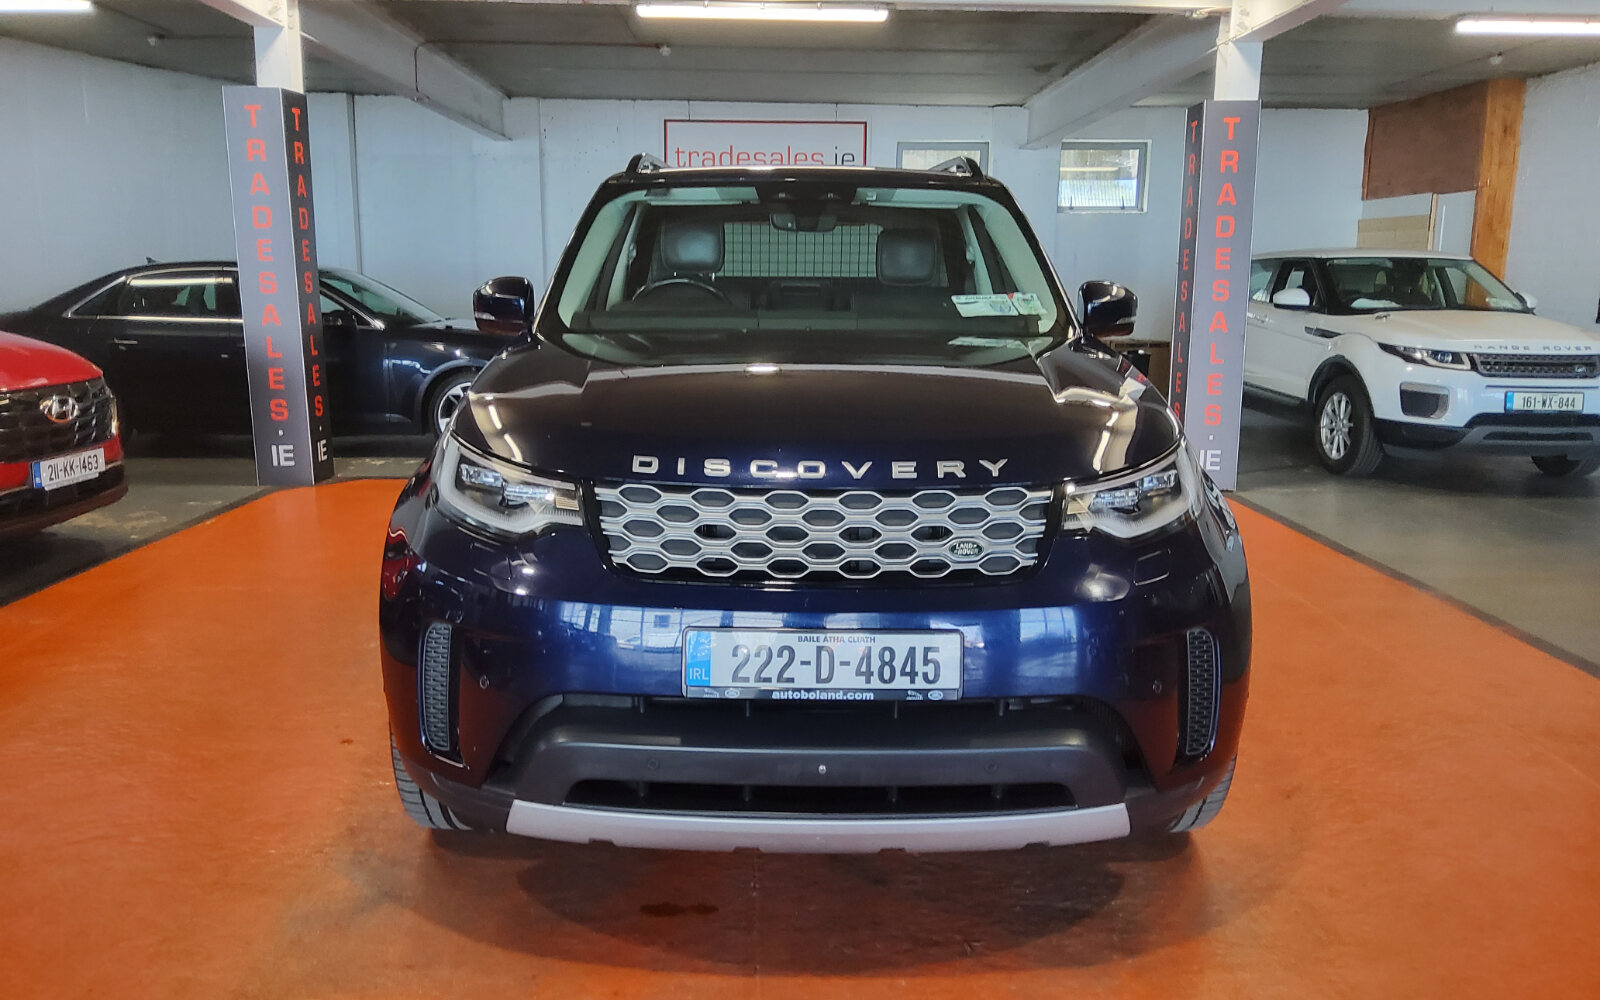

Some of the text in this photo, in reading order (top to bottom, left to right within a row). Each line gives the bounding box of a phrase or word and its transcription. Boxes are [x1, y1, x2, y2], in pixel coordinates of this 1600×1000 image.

[675, 145, 856, 167] tradesalesie
[1522, 396, 1576, 409] 161-WX-844
[47, 454, 99, 481] 211-KK-1463
[632, 455, 1008, 479] DISCOVERY
[797, 635, 821, 643] BAILE
[731, 644, 941, 685] 222-D-4845
[689, 667, 709, 681] IRL
[771, 690, 874, 700] autoboland.com
